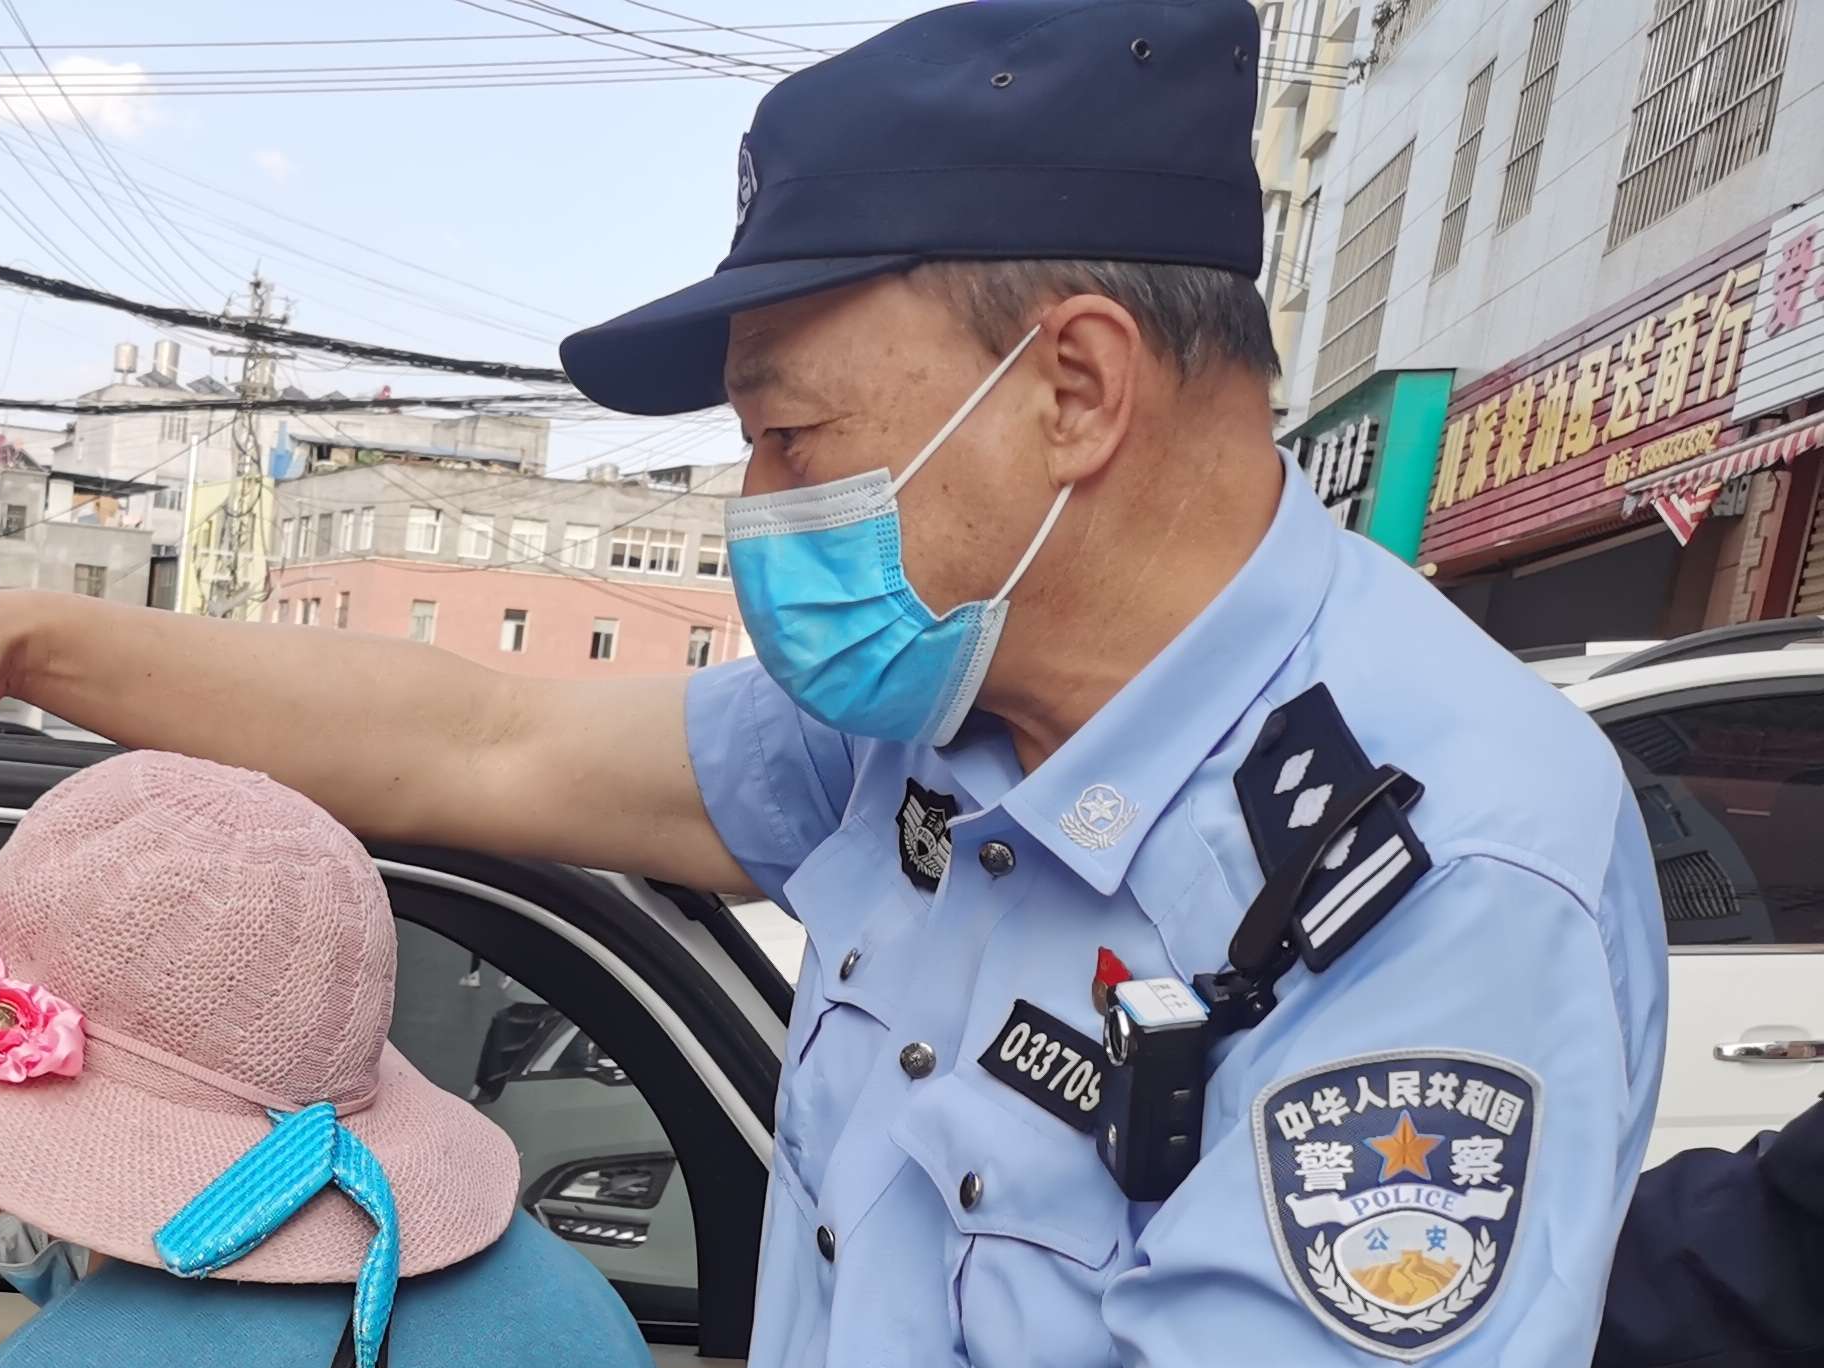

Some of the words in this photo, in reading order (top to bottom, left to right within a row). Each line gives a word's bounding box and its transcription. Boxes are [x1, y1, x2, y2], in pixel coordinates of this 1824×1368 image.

[1275, 1070, 1525, 1140] 中华人民共和国
[1349, 1186, 1455, 1216] POLICE
